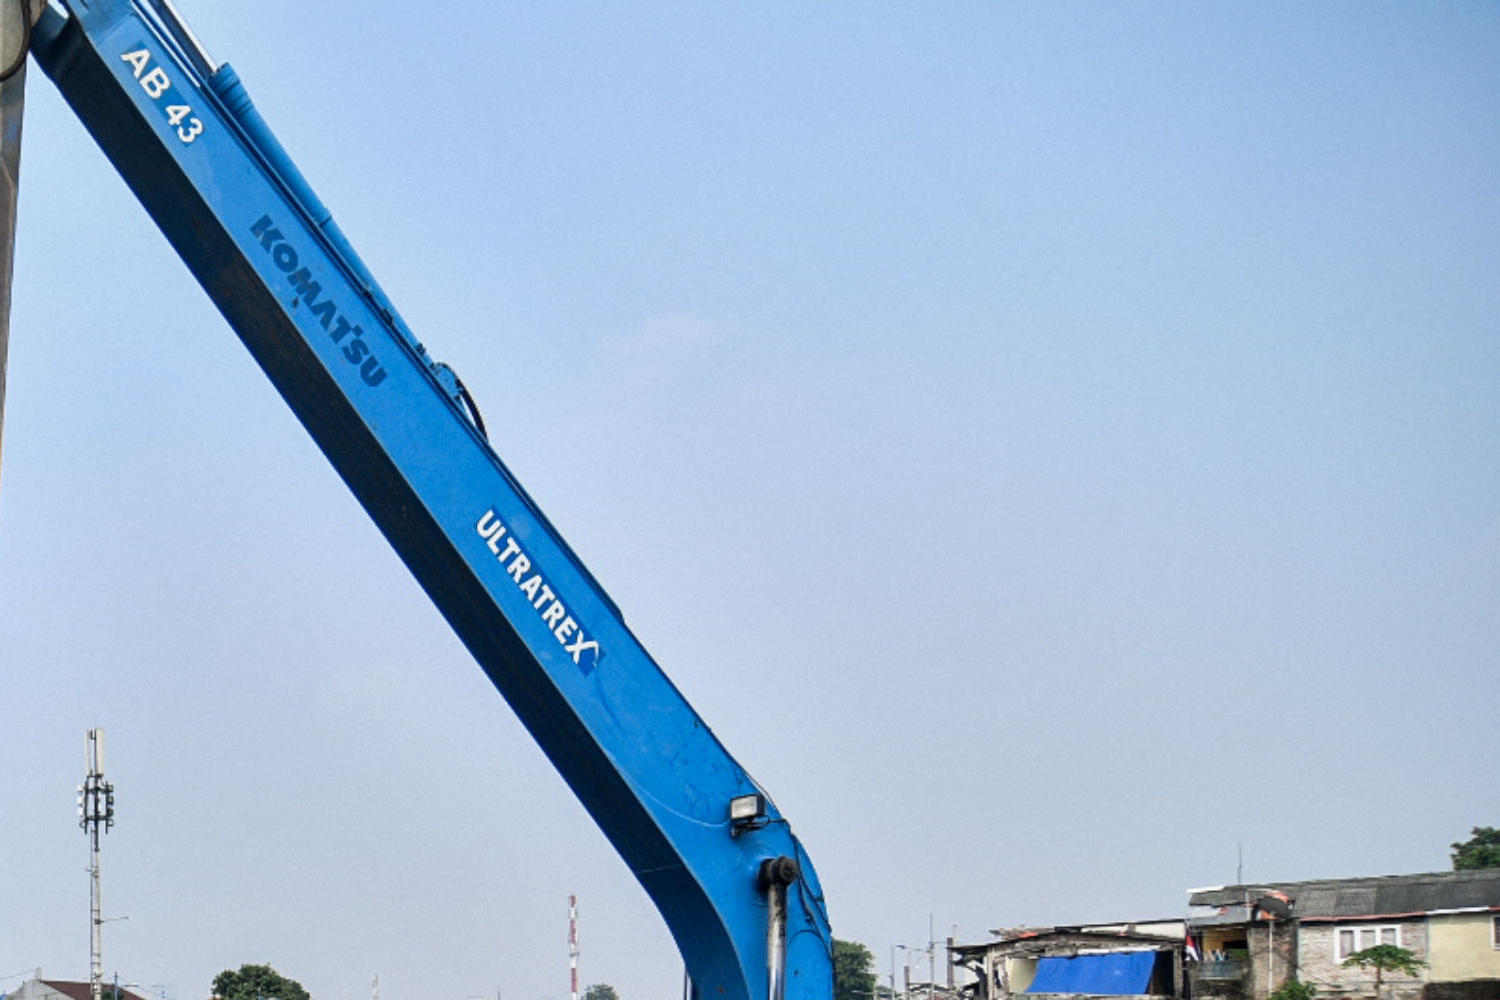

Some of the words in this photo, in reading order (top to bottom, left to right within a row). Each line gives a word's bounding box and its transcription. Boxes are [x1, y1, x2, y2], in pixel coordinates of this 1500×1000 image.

[120, 49, 171, 99] AB
[165, 105, 203, 143] 43
[249, 214, 388, 387] KOMATSU
[476, 509, 599, 667] ULTRATREX
